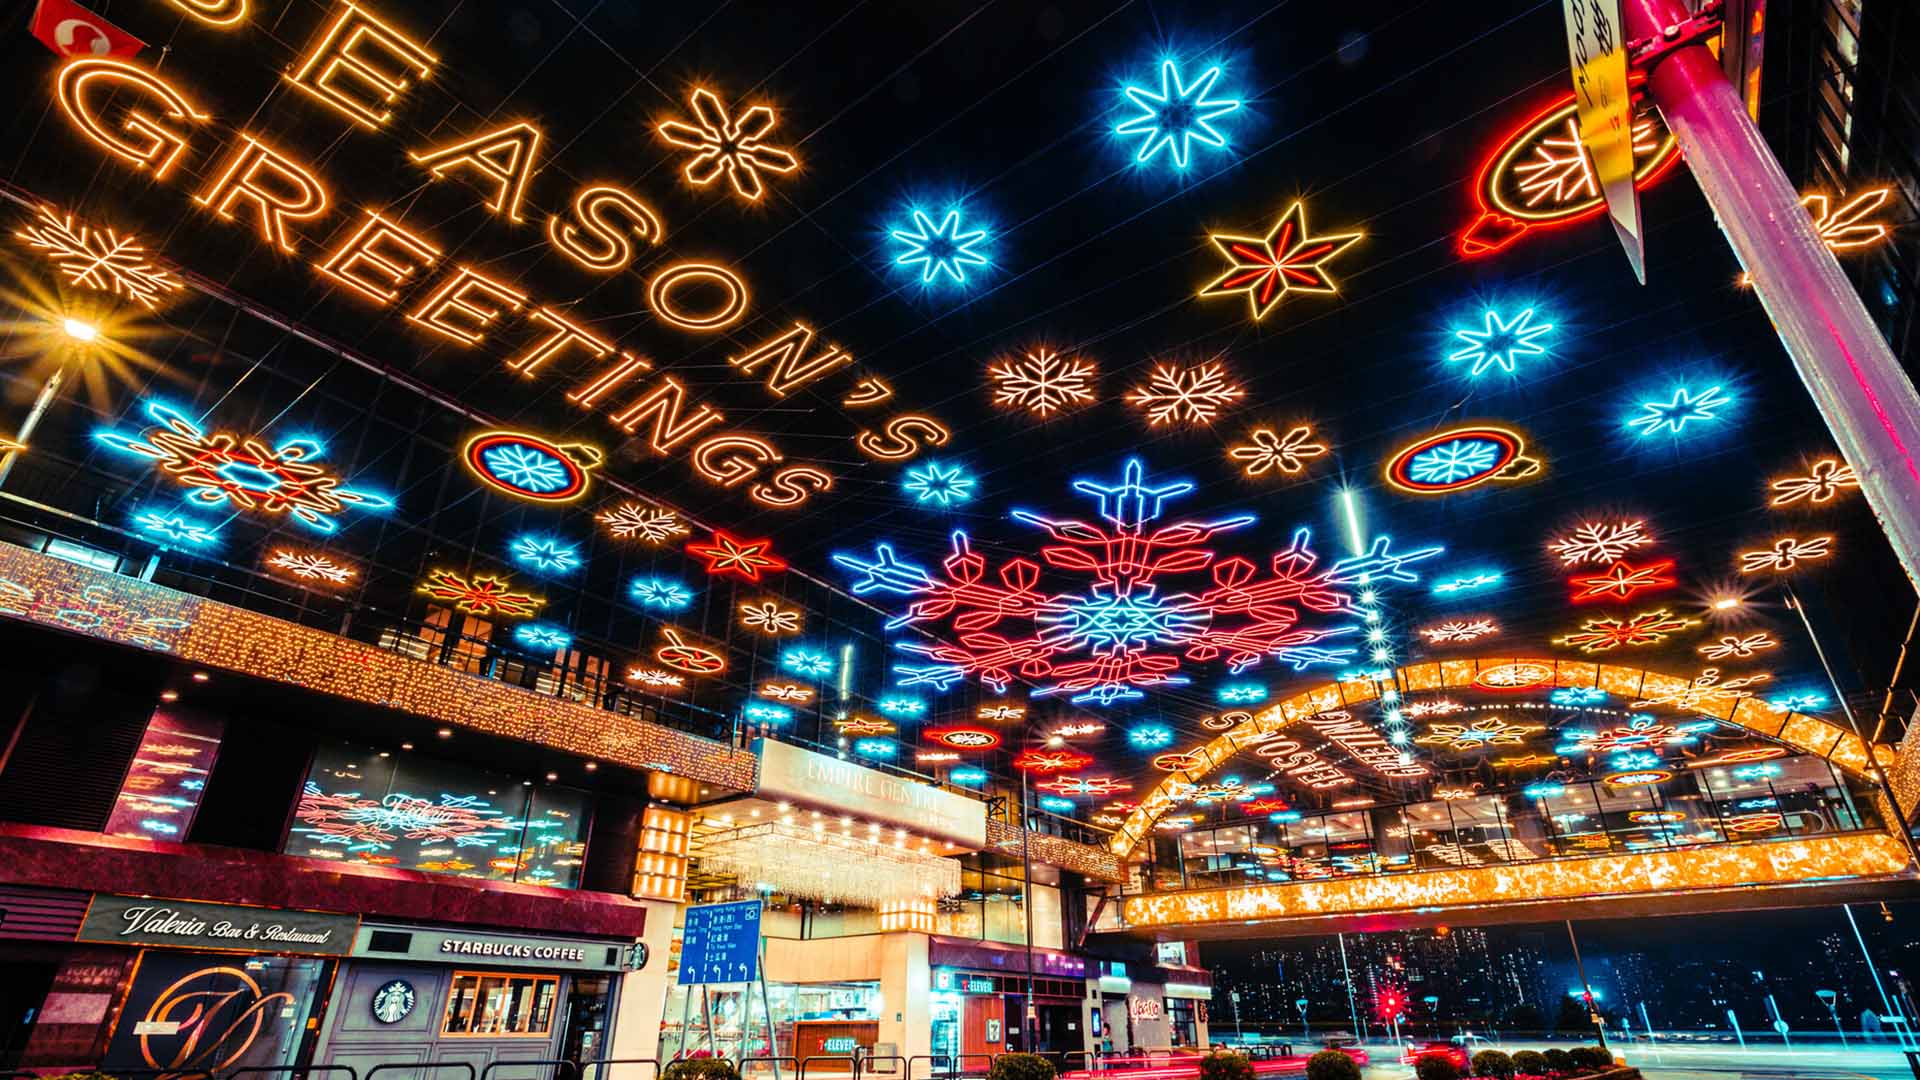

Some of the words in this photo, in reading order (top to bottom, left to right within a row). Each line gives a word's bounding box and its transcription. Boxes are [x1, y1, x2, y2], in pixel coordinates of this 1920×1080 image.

[172, 0, 949, 459] EASON'S
[57, 58, 834, 508] GREETINGS
[808, 757, 874, 797] EMPIRE
[120, 906, 206, 936] Valeria
[208, 920, 243, 938] Bar
[243, 923, 261, 940] &
[259, 924, 332, 945] Restaurant
[441, 938, 531, 958] STARBUCKS
[534, 948, 585, 961] COFFEE
